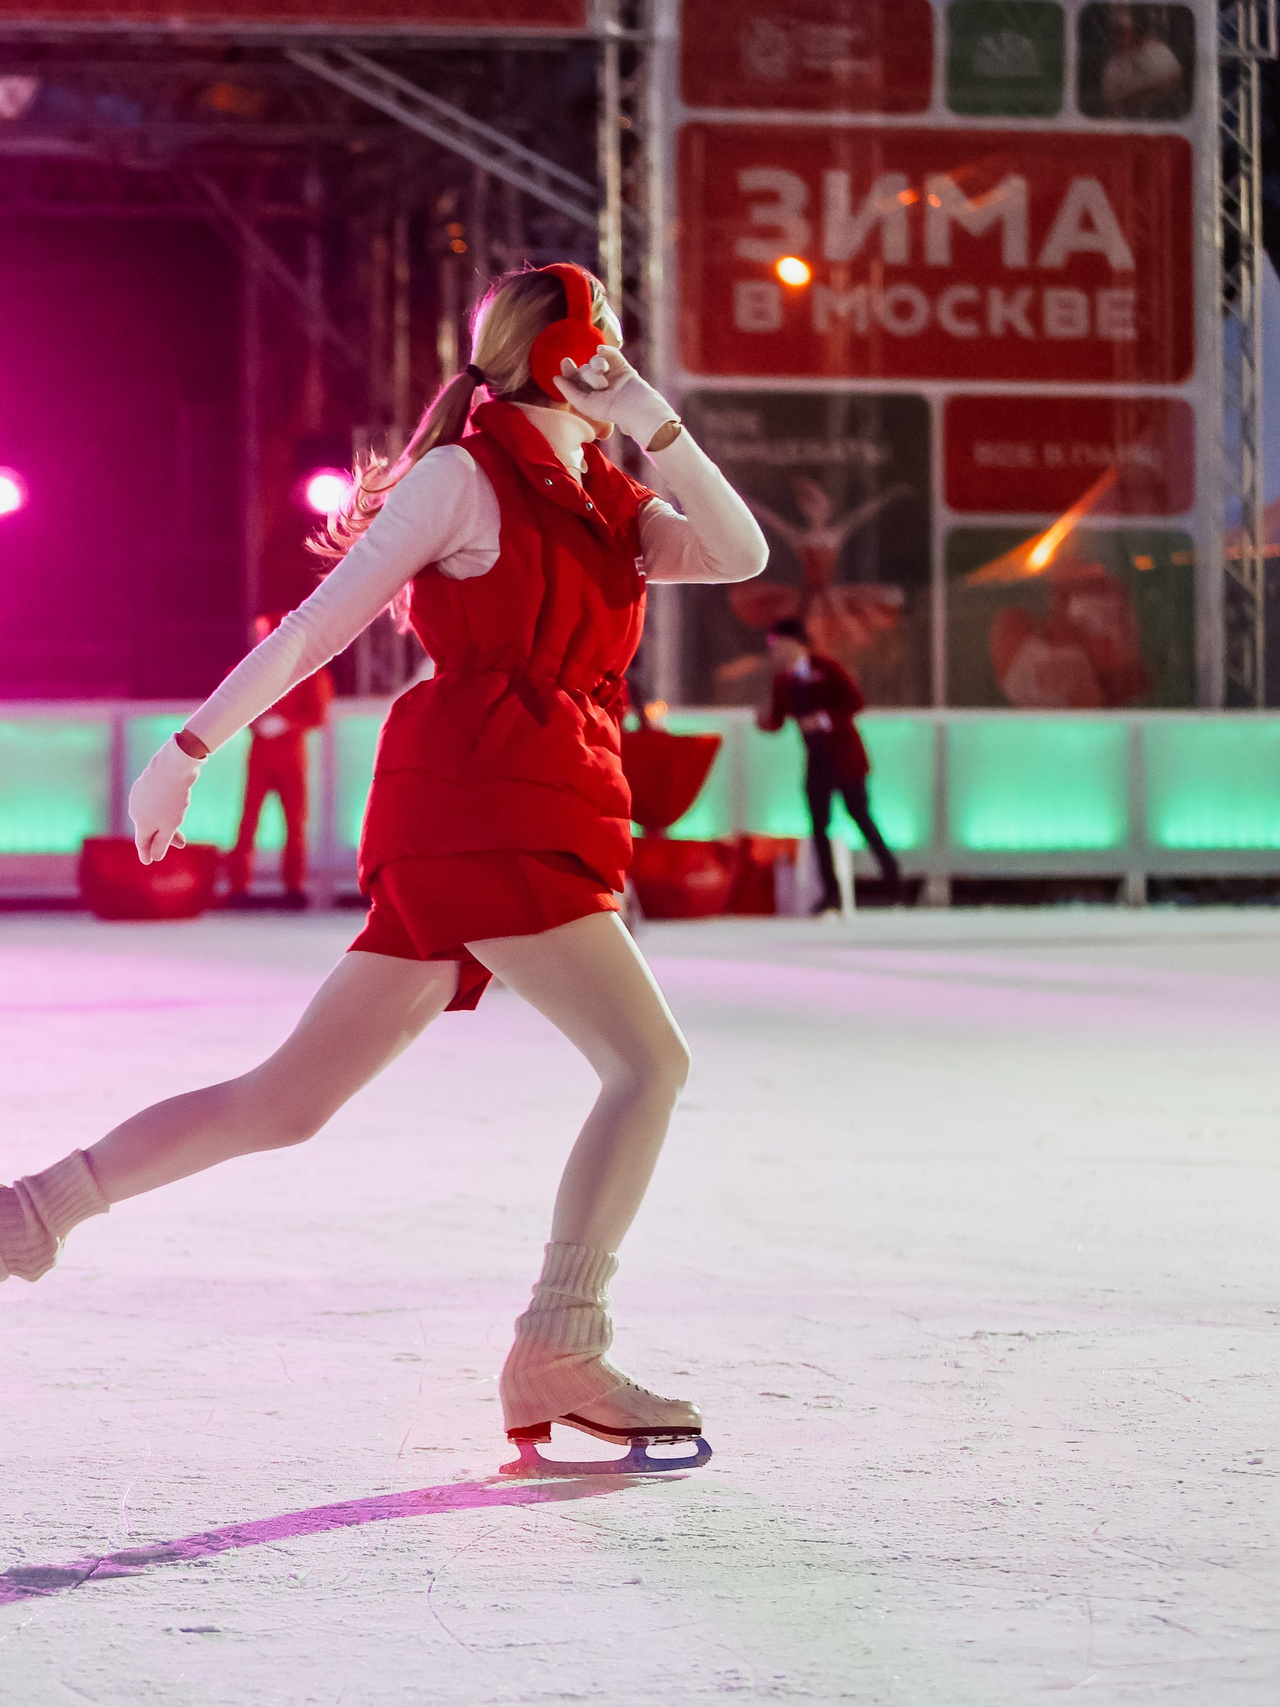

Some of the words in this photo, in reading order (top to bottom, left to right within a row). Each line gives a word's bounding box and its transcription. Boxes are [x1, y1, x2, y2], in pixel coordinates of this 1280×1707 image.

[734, 166, 1136, 270] ЗИМА
[734, 280, 782, 332] В
[814, 284, 1138, 341] МОСКВЕ
